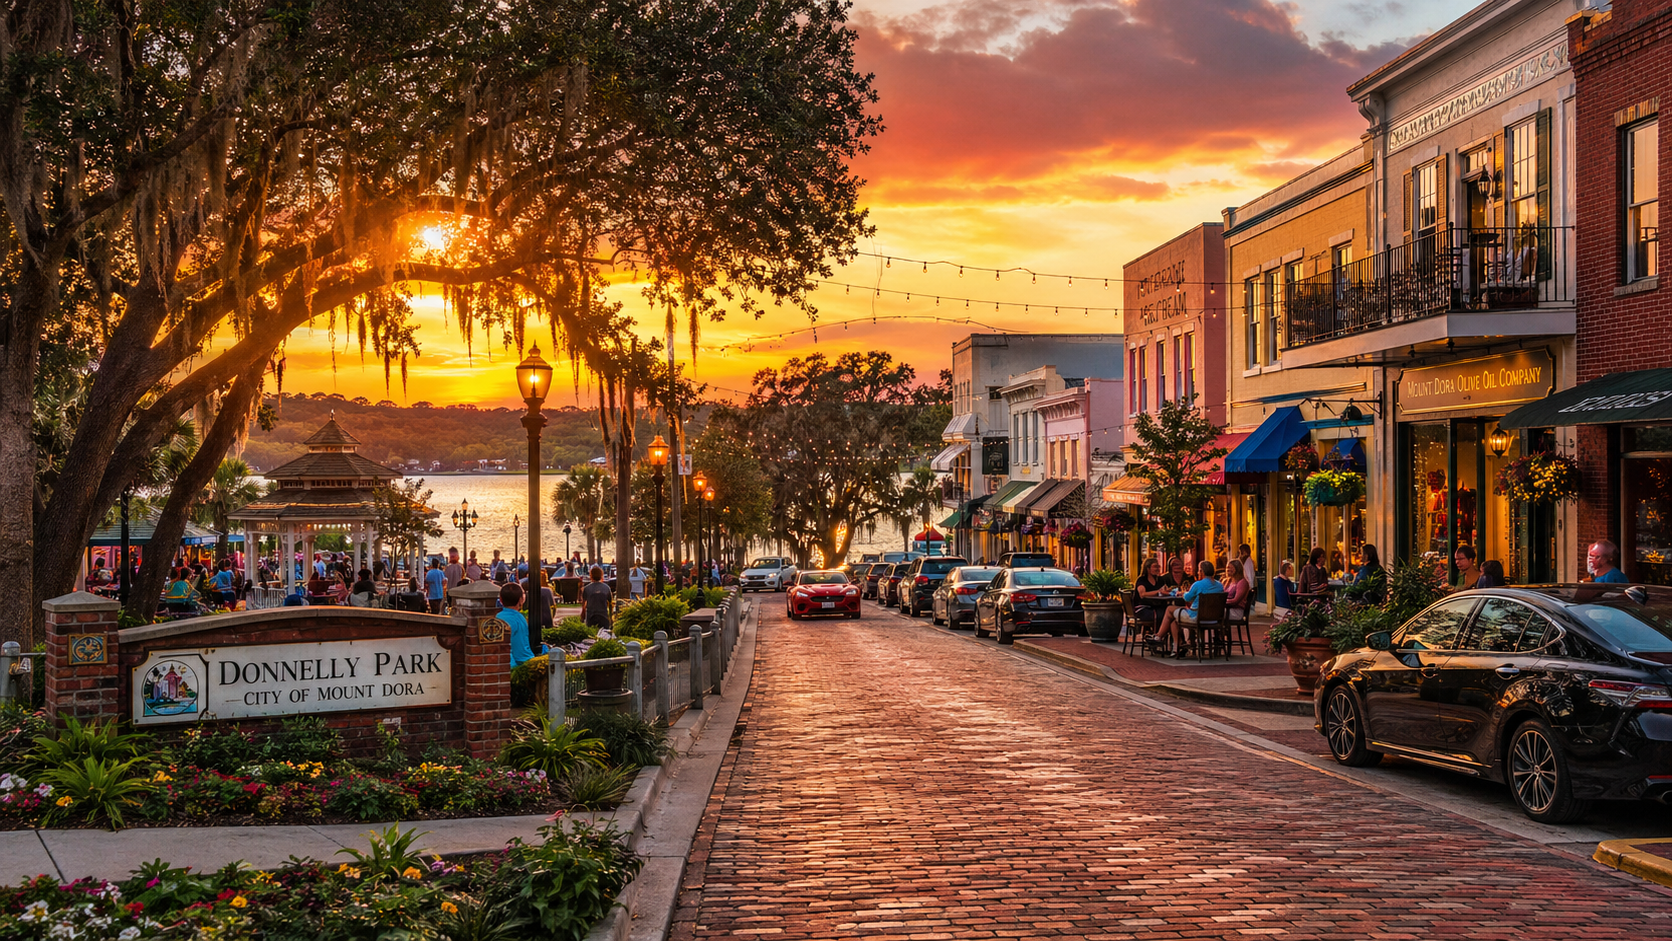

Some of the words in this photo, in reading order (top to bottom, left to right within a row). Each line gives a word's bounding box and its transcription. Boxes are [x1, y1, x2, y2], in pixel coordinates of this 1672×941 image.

[1407, 380, 1433, 398] MOUNT
[1434, 377, 1455, 395] DORA
[1457, 374, 1480, 392] OLIVE
[1482, 370, 1497, 389] OIL
[1499, 366, 1542, 388] COMPANY
[218, 656, 361, 686] DONNELLY
[374, 652, 442, 676] PARK
[243, 690, 282, 706] CITY
[289, 688, 310, 703] OF
[317, 684, 375, 702] MOUNT
[382, 682, 425, 697] DORA
